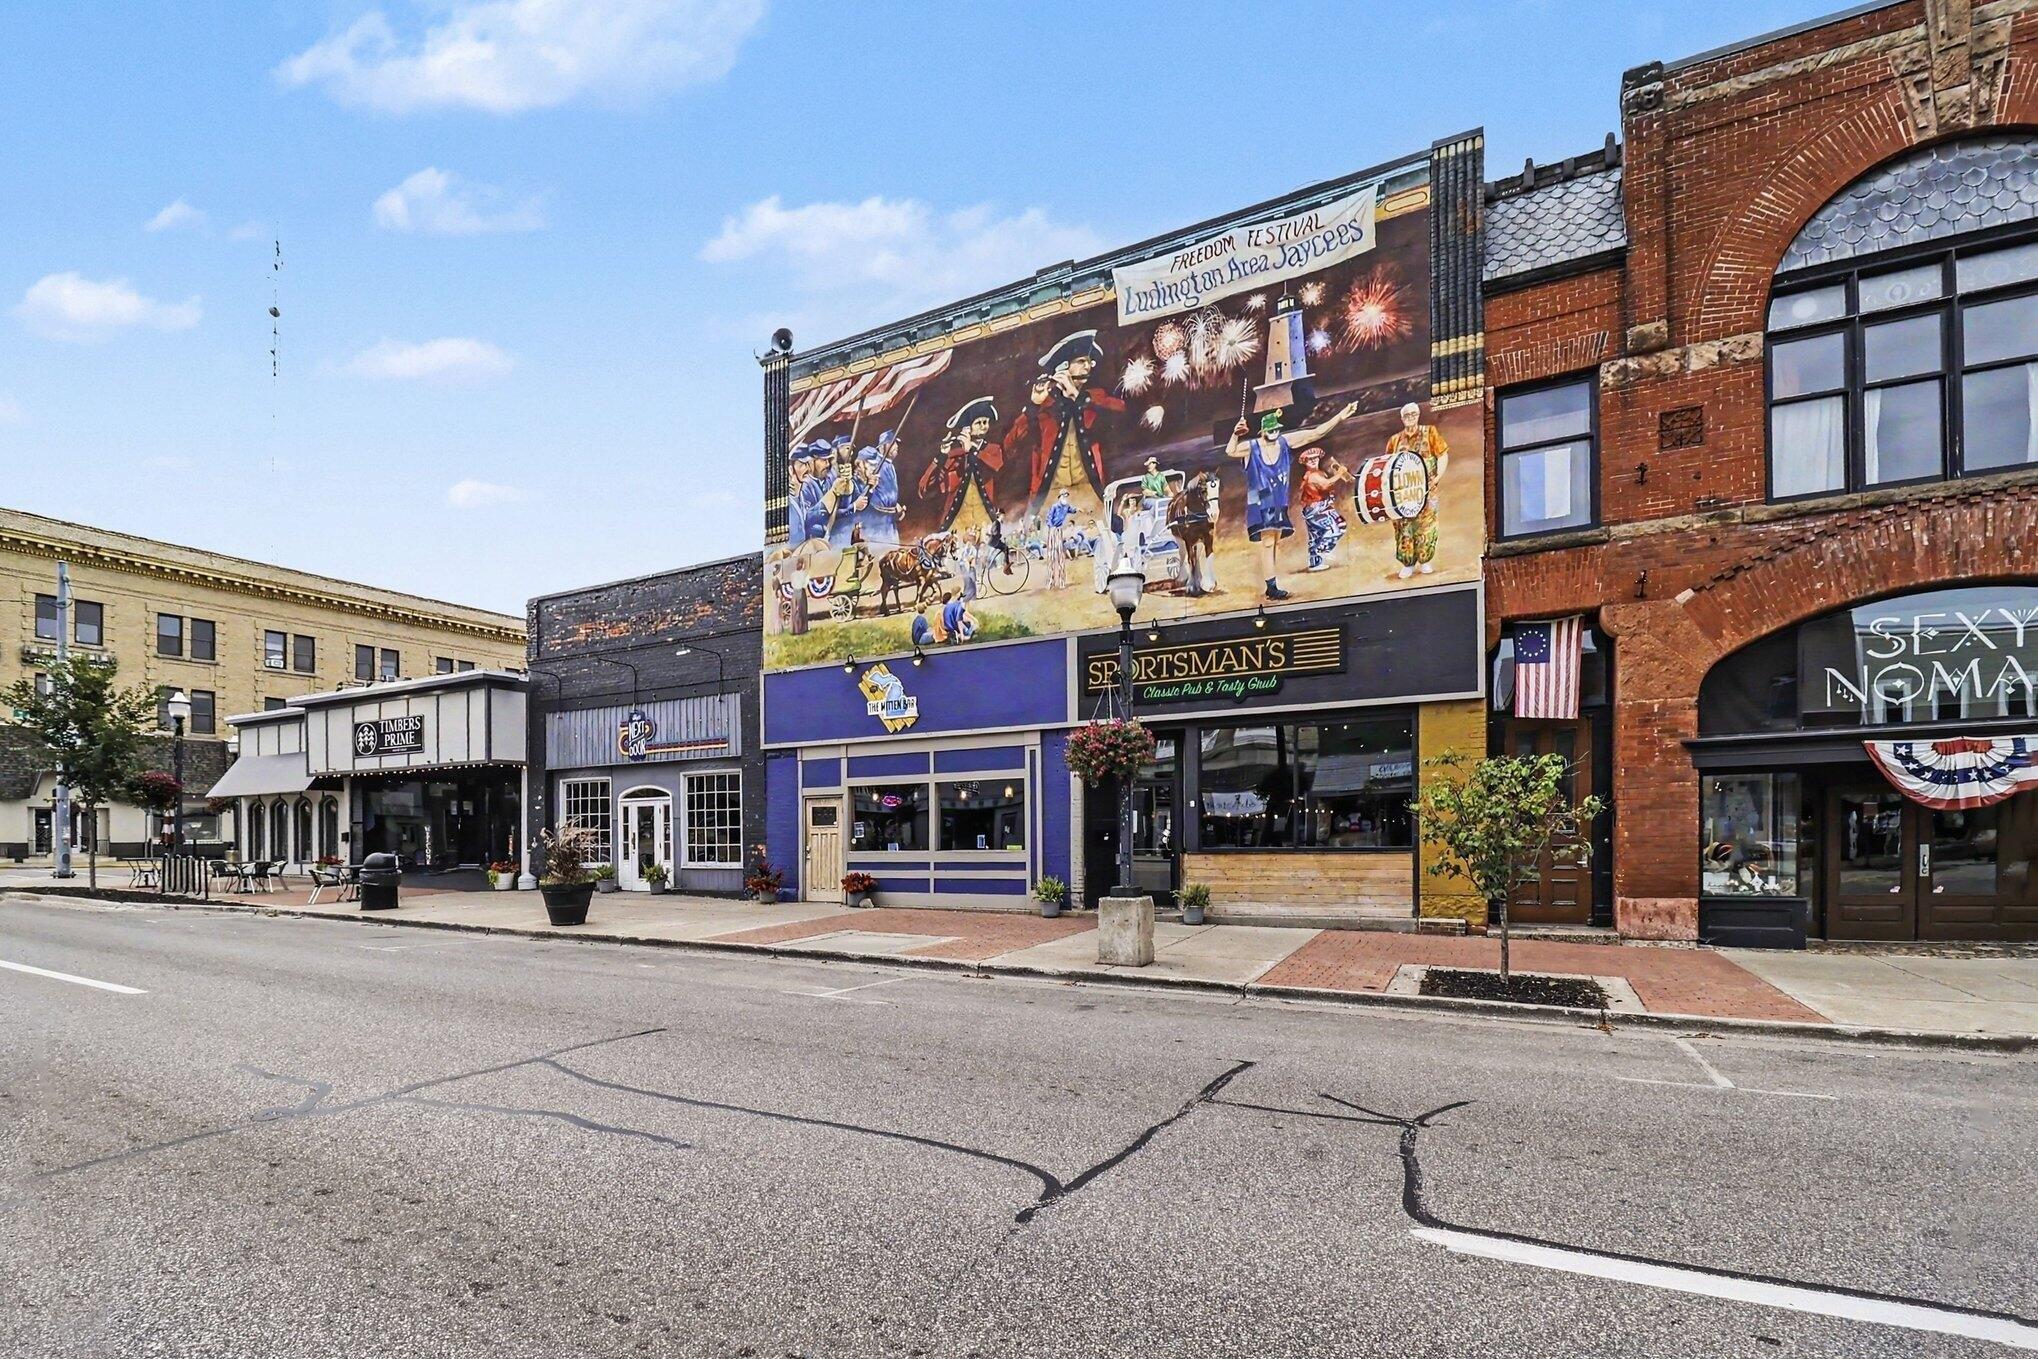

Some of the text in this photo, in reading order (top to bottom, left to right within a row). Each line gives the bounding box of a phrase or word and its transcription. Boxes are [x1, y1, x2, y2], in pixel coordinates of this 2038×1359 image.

[1170, 213, 1325, 273] FREEDOM FESTIVAL
[1125, 218, 1363, 315] Ludington Area Jaycees
[1866, 607, 2038, 659] SEXY
[1143, 675, 1277, 699] Classic Pub & Tasty Grub
[868, 702, 879, 713] THE
[379, 717, 421, 733] TIMBERS
[628, 721, 645, 741] NEXT
[384, 732, 415, 746] PRIME
[629, 739, 646, 756] DOOR
